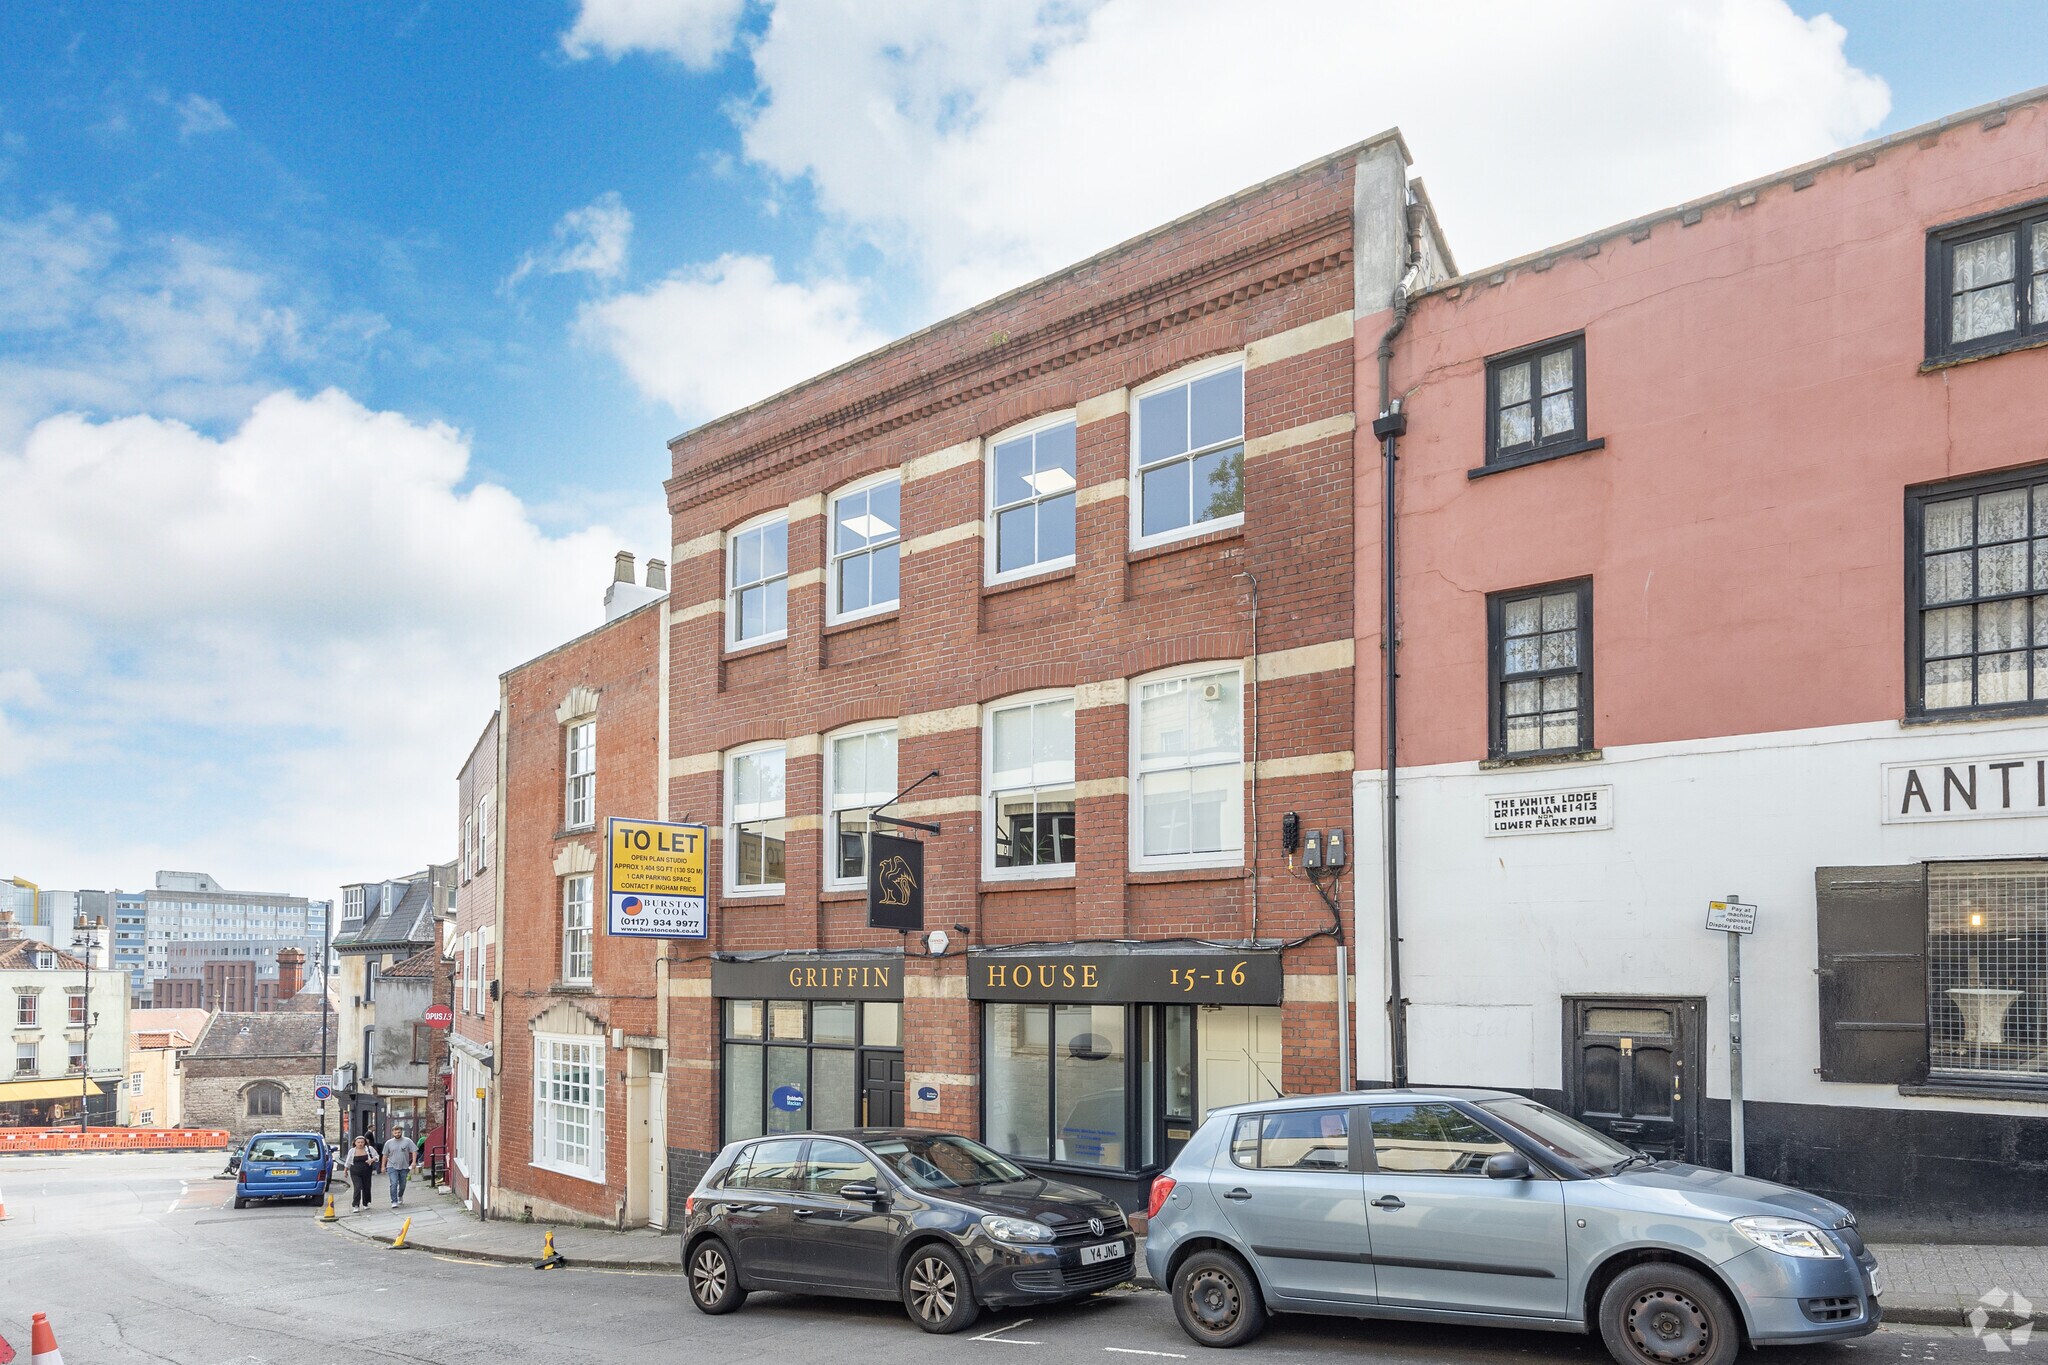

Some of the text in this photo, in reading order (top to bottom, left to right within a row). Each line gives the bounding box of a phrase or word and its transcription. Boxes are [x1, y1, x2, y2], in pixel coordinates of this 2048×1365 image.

[1901, 760, 2046, 814] ANTI
[1494, 792, 1598, 809] THE WHITE LODGE
[1494, 802, 1597, 818] GRIFFIN LANE 1413
[1494, 816, 1597, 831] LOWER PARK ROW
[619, 828, 699, 853] TO LET
[645, 874, 672, 882] PARKING
[620, 882, 649, 890] CONTACT
[644, 899, 700, 909] BURSTON
[654, 907, 688, 916] COOK
[620, 917, 649, 926] (0117)
[675, 920, 699, 928] 9977
[1709, 921, 1731, 929] Display
[789, 967, 890, 987] GRIFFIN
[987, 961, 1248, 992] HOUSE 15-16
[1621, 1048, 1633, 1056] 14
[1090, 1244, 1118, 1261] Y4 JNG
